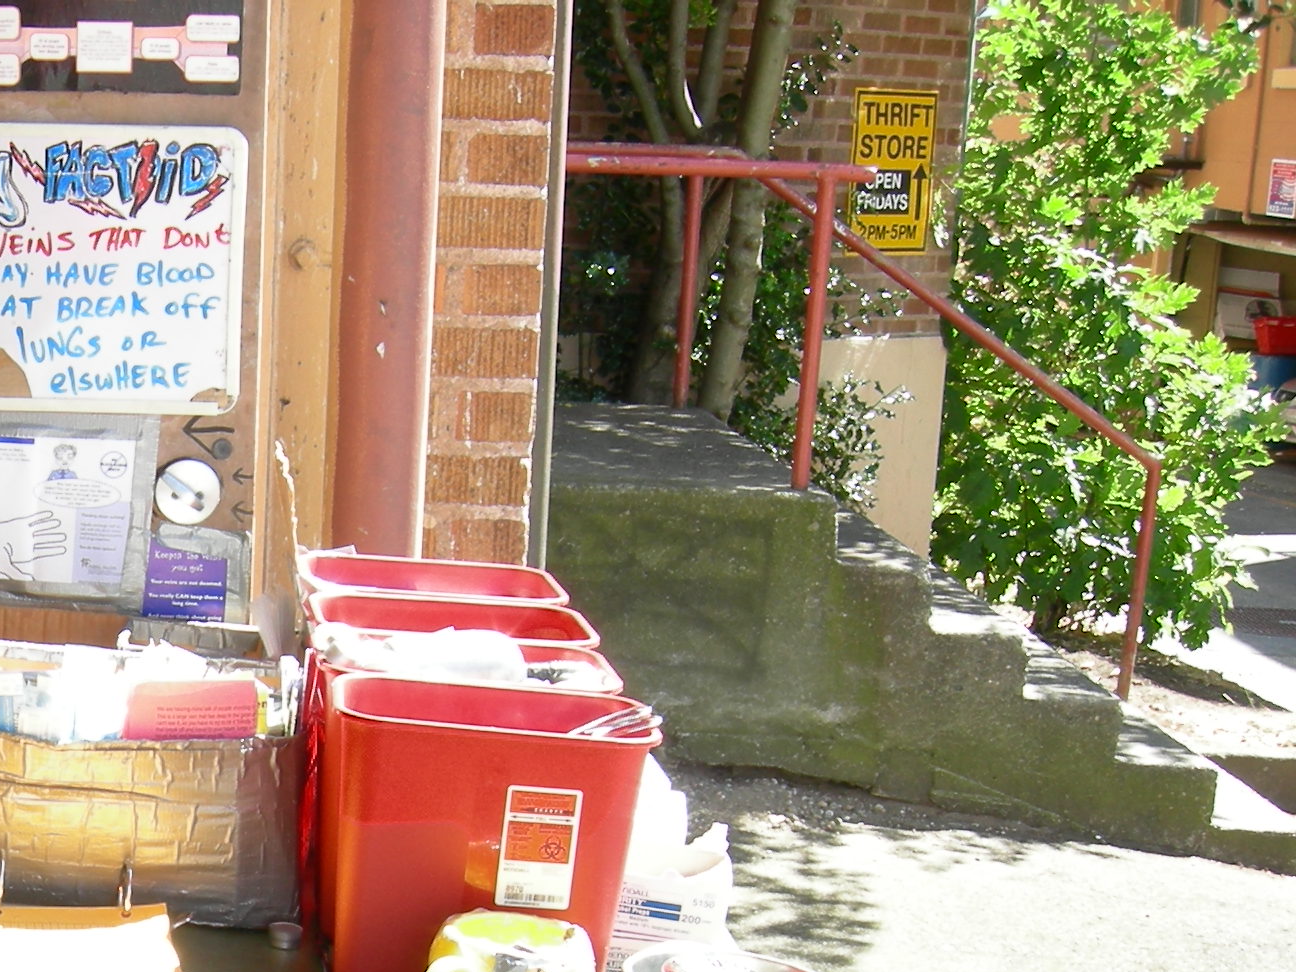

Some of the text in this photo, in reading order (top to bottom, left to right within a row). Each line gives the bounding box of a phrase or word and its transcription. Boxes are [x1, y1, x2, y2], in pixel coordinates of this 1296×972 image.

[862, 101, 934, 127] THRIFT
[859, 134, 929, 160] STORE
[89, 227, 145, 249] THAT
[859, 223, 918, 241] 2PM-5PM
[46, 263, 118, 287] HAVE
[56, 291, 149, 321] BREAK
[165, 296, 222, 319] off
[122, 331, 166, 351] OR
[682, 915, 702, 924] 200
